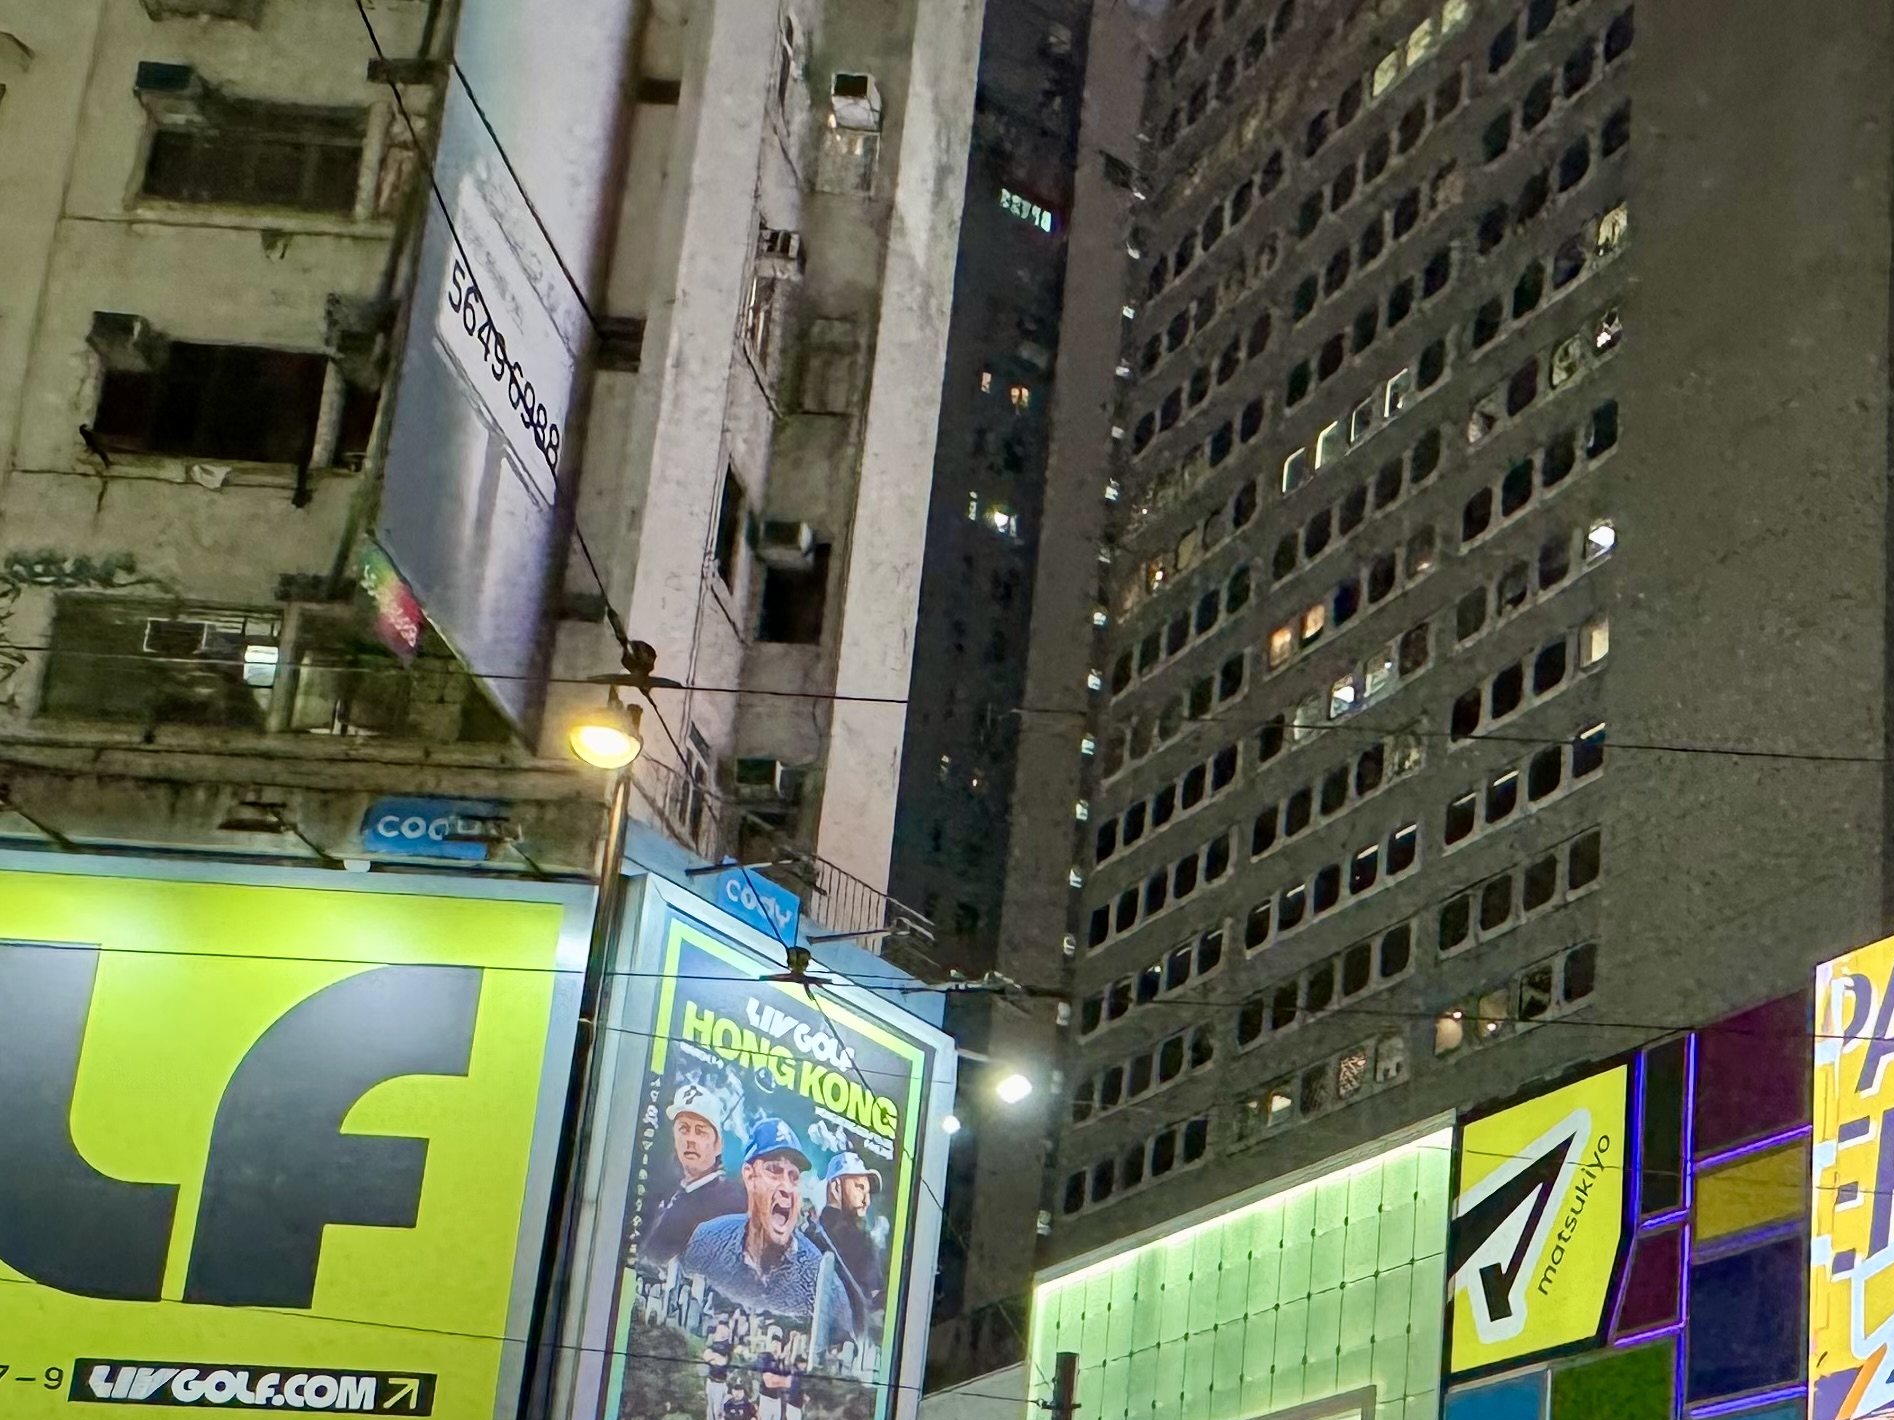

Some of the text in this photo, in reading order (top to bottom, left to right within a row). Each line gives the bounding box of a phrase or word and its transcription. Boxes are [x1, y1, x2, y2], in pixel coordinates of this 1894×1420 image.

[682, 1000, 797, 1090] HONG
[799, 1060, 899, 1143] KONG
[1538, 1132, 1613, 1297] matsukiyo
